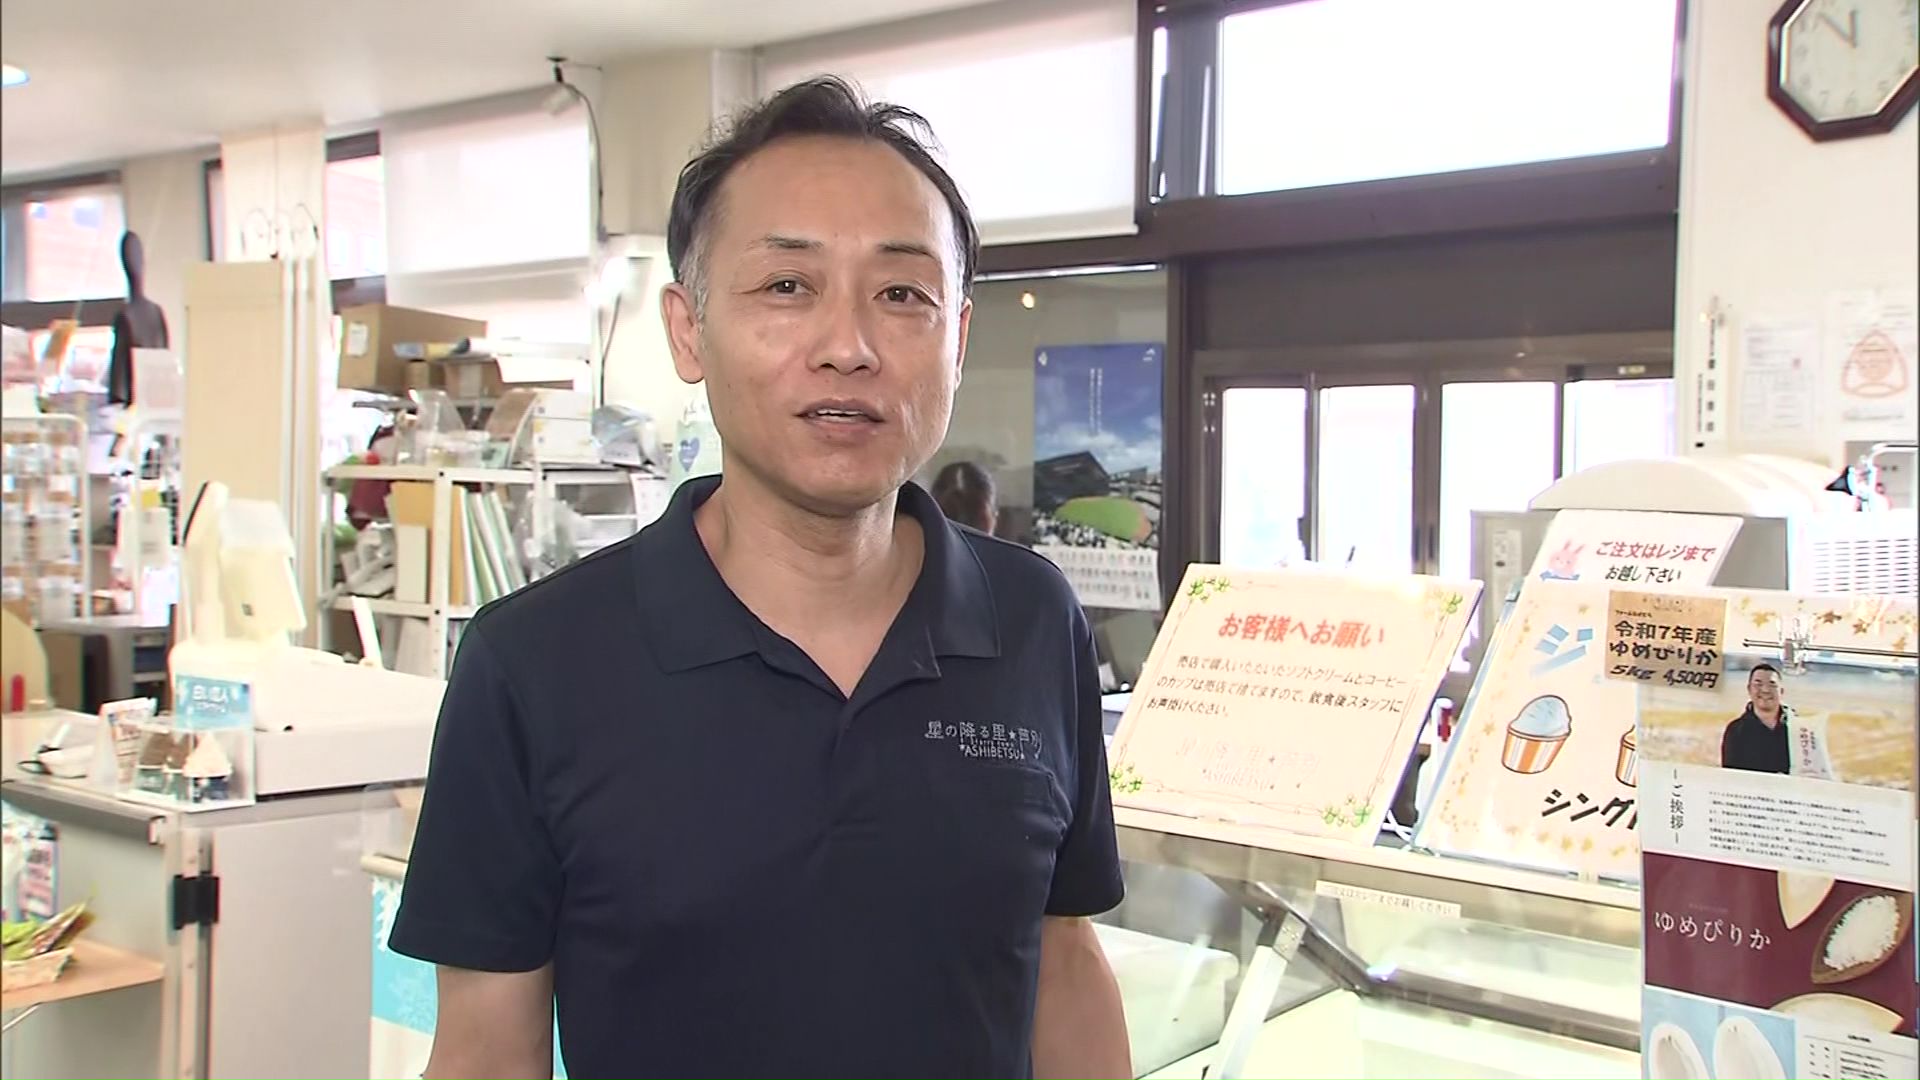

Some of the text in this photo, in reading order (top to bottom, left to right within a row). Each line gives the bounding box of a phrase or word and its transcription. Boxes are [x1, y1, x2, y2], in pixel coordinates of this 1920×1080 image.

[1596, 540, 1717, 562] ご注文はレジまで
[1605, 564, 1683, 582] お越し下さい
[1218, 612, 1384, 649] お客様へお願い
[1615, 620, 1717, 646] 令和7年産
[1609, 641, 1718, 666] ゆめぴりか
[1663, 669, 1719, 688] 4,500円
[964, 745, 1020, 760] ASHIBETSU
[1653, 911, 1772, 952] ゆめぴりか
